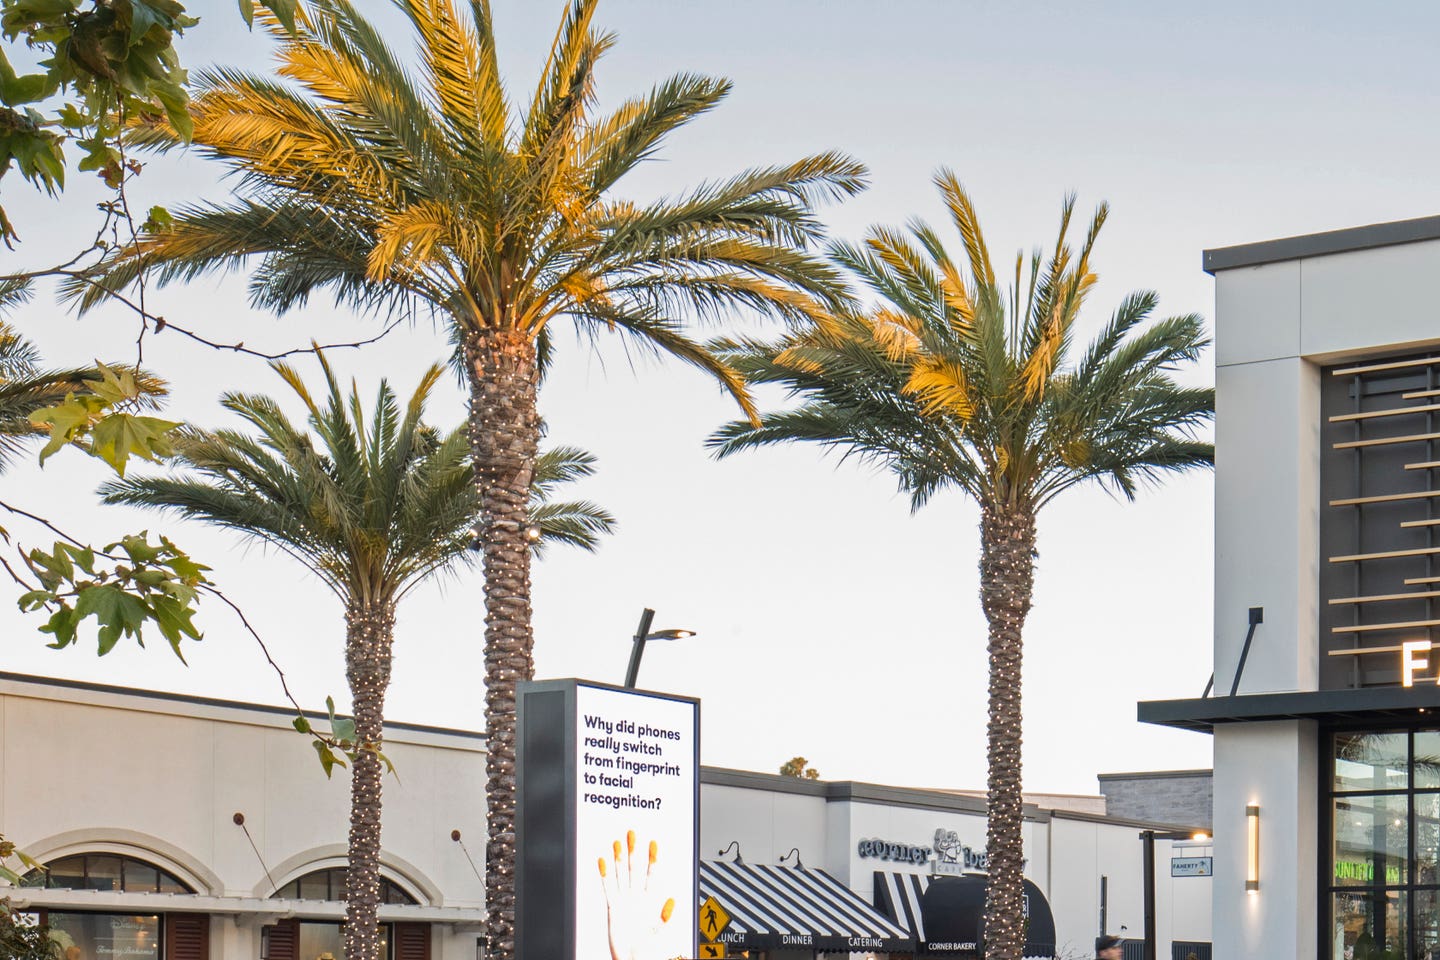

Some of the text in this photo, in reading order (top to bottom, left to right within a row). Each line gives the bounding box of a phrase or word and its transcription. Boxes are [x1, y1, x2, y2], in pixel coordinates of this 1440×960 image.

[584, 715, 680, 741] Why did phones
[584, 737, 662, 756] really switch
[584, 752, 680, 776] from fingerprint
[584, 772, 633, 788] to facial
[584, 793, 661, 810] recognition?
[783, 935, 813, 945] DINNER
[848, 937, 883, 948] CATERING
[929, 942, 977, 951] CORNER BAKERY
